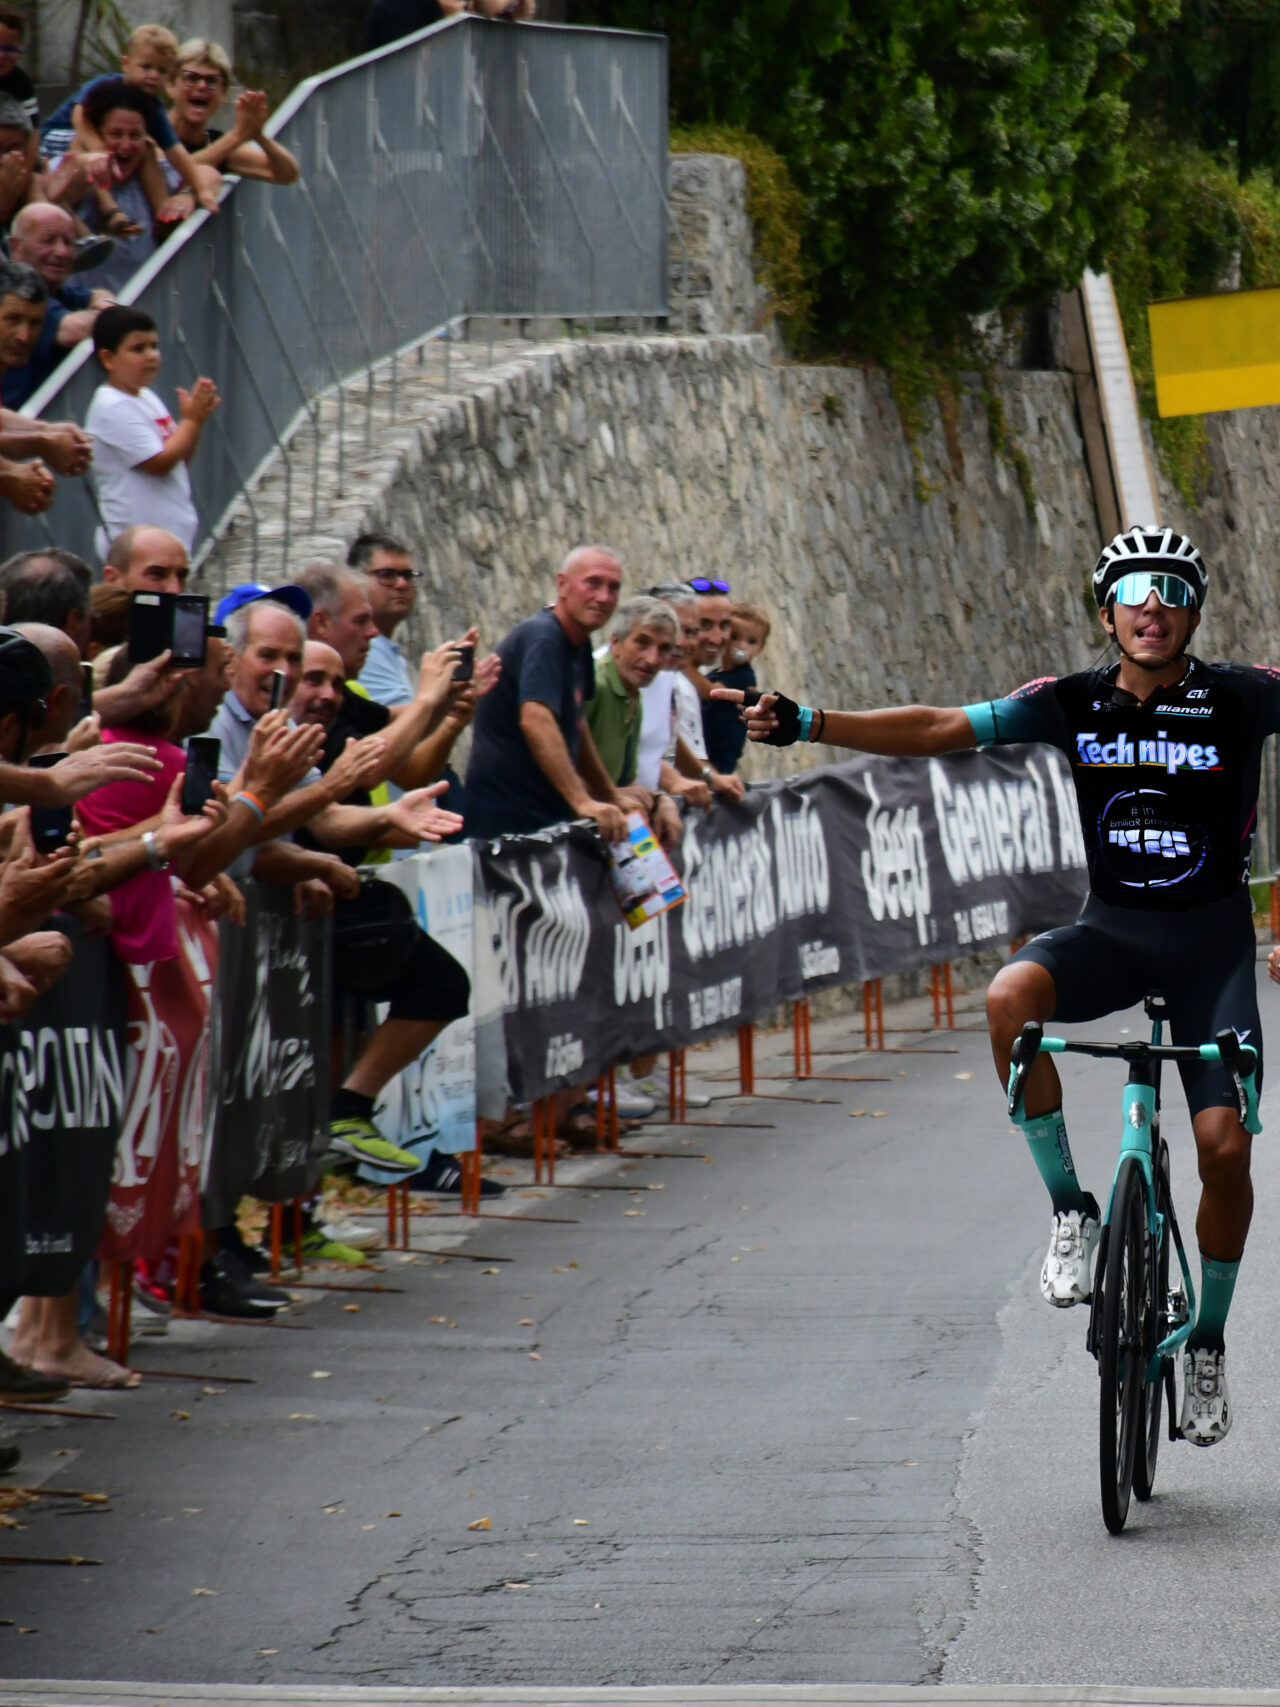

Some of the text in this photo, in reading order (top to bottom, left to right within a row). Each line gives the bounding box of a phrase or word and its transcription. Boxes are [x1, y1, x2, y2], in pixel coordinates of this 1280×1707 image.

[1155, 704, 1214, 715] Bianchi
[682, 811, 777, 962] General
[771, 794, 830, 922] Auto
[861, 771, 931, 946] Jeep
[929, 756, 1053, 887] General
[525, 848, 590, 1006] Auto
